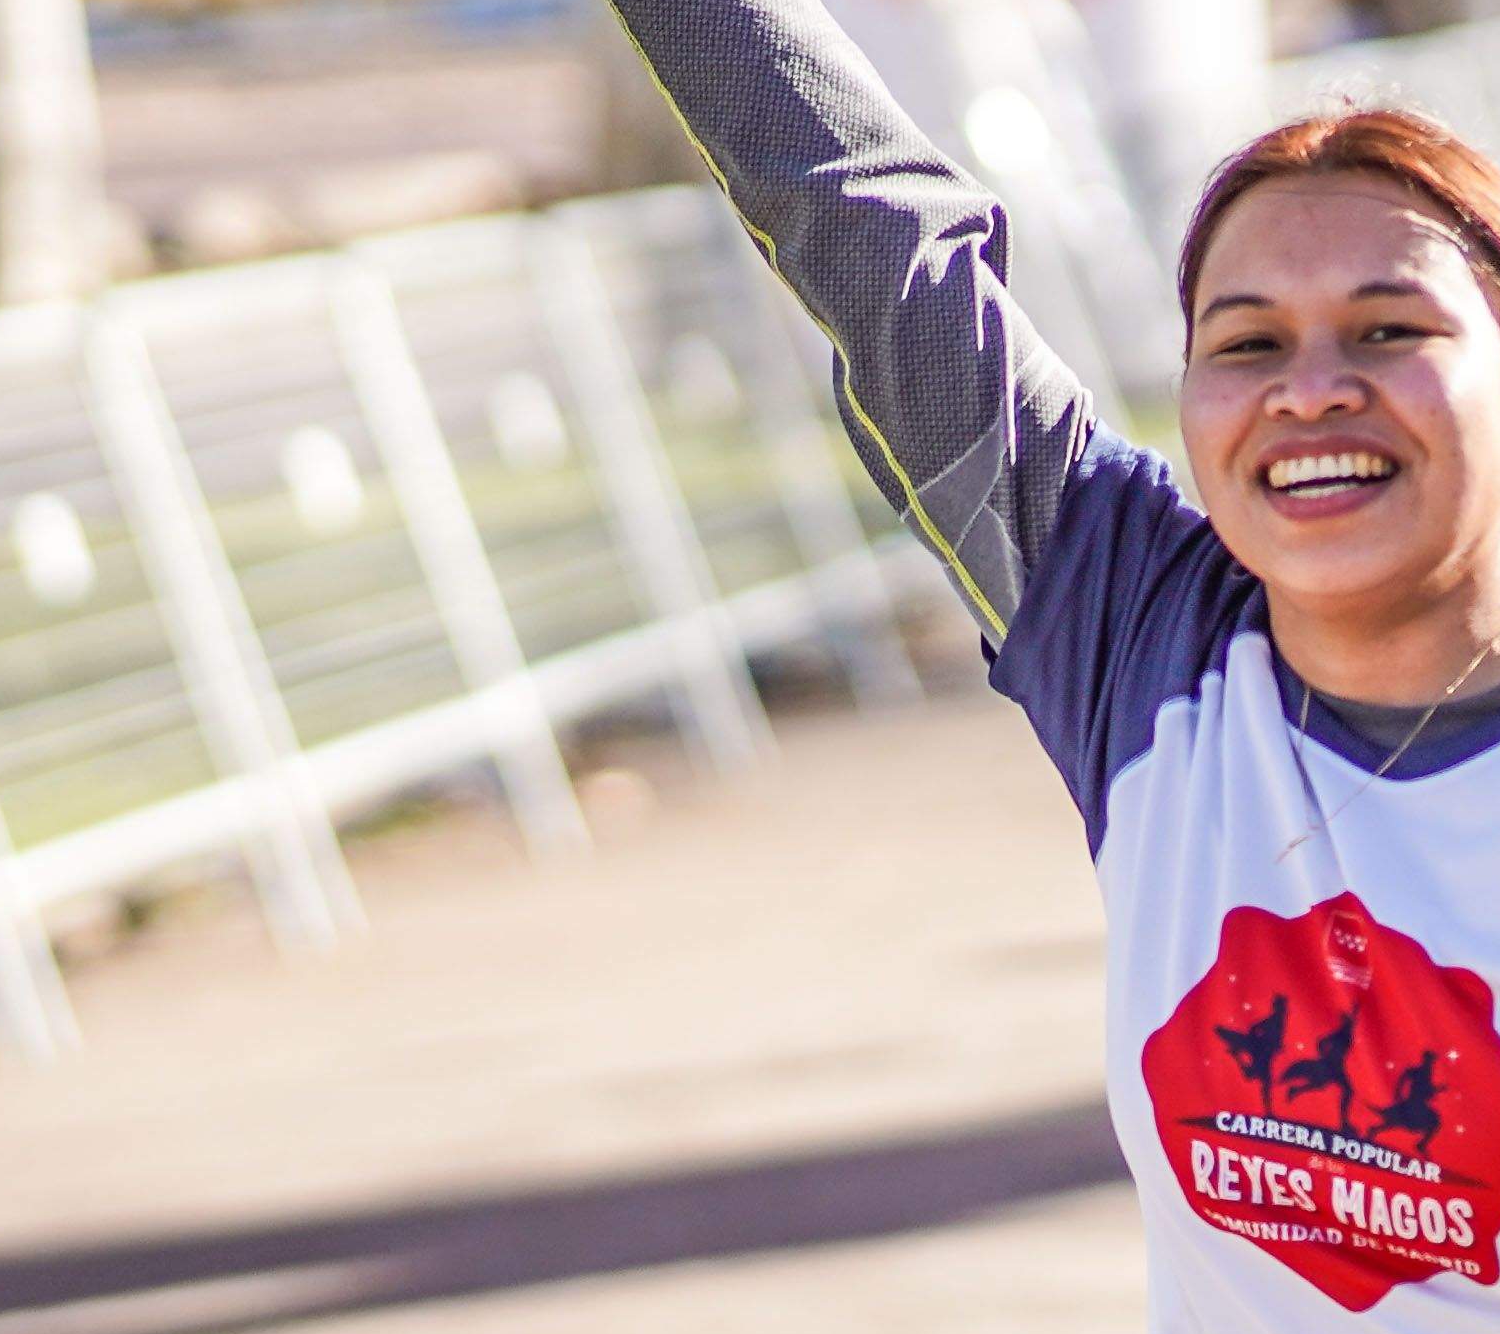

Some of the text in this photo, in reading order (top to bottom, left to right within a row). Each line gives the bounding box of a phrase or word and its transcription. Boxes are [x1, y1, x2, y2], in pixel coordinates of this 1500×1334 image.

[1215, 1111, 1442, 1183] CARRERA POPULAR
[1190, 1139, 1475, 1247] REYES MAGOS
